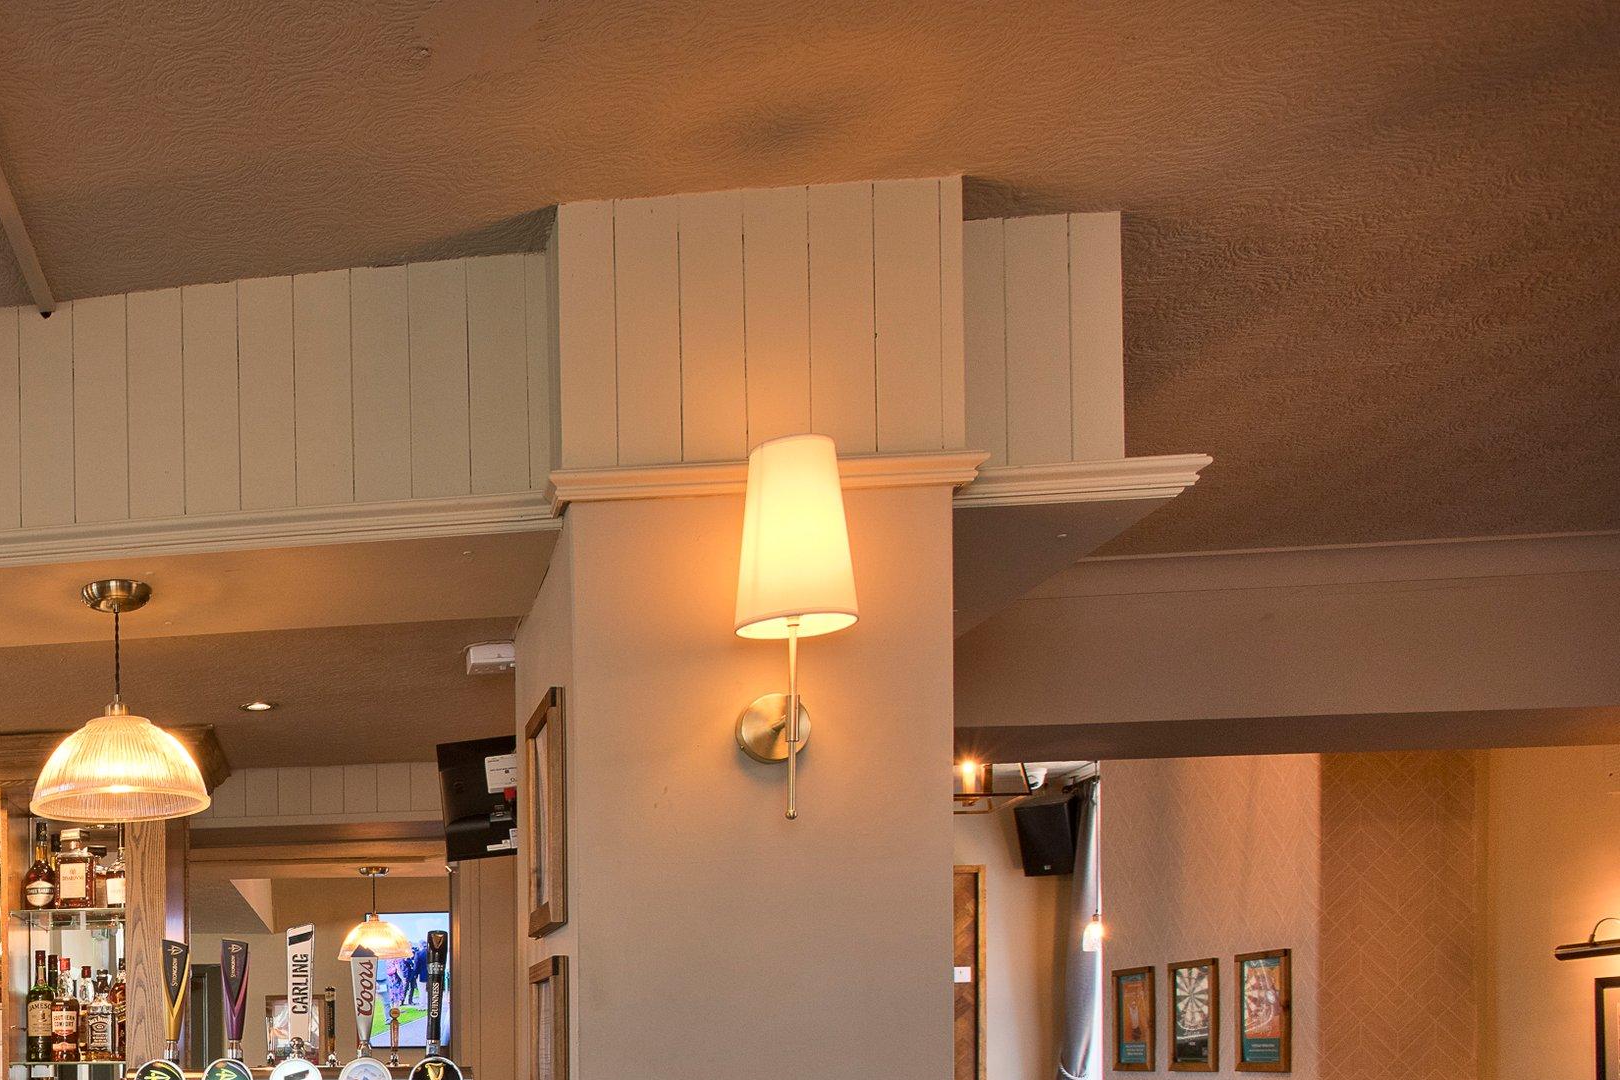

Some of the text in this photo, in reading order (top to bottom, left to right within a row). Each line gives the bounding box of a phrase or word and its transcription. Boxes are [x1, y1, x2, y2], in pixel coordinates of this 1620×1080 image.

[292, 953, 309, 1014] CARLING
[357, 960, 374, 1017] Coors
[430, 982, 440, 1018] GUINNESS
